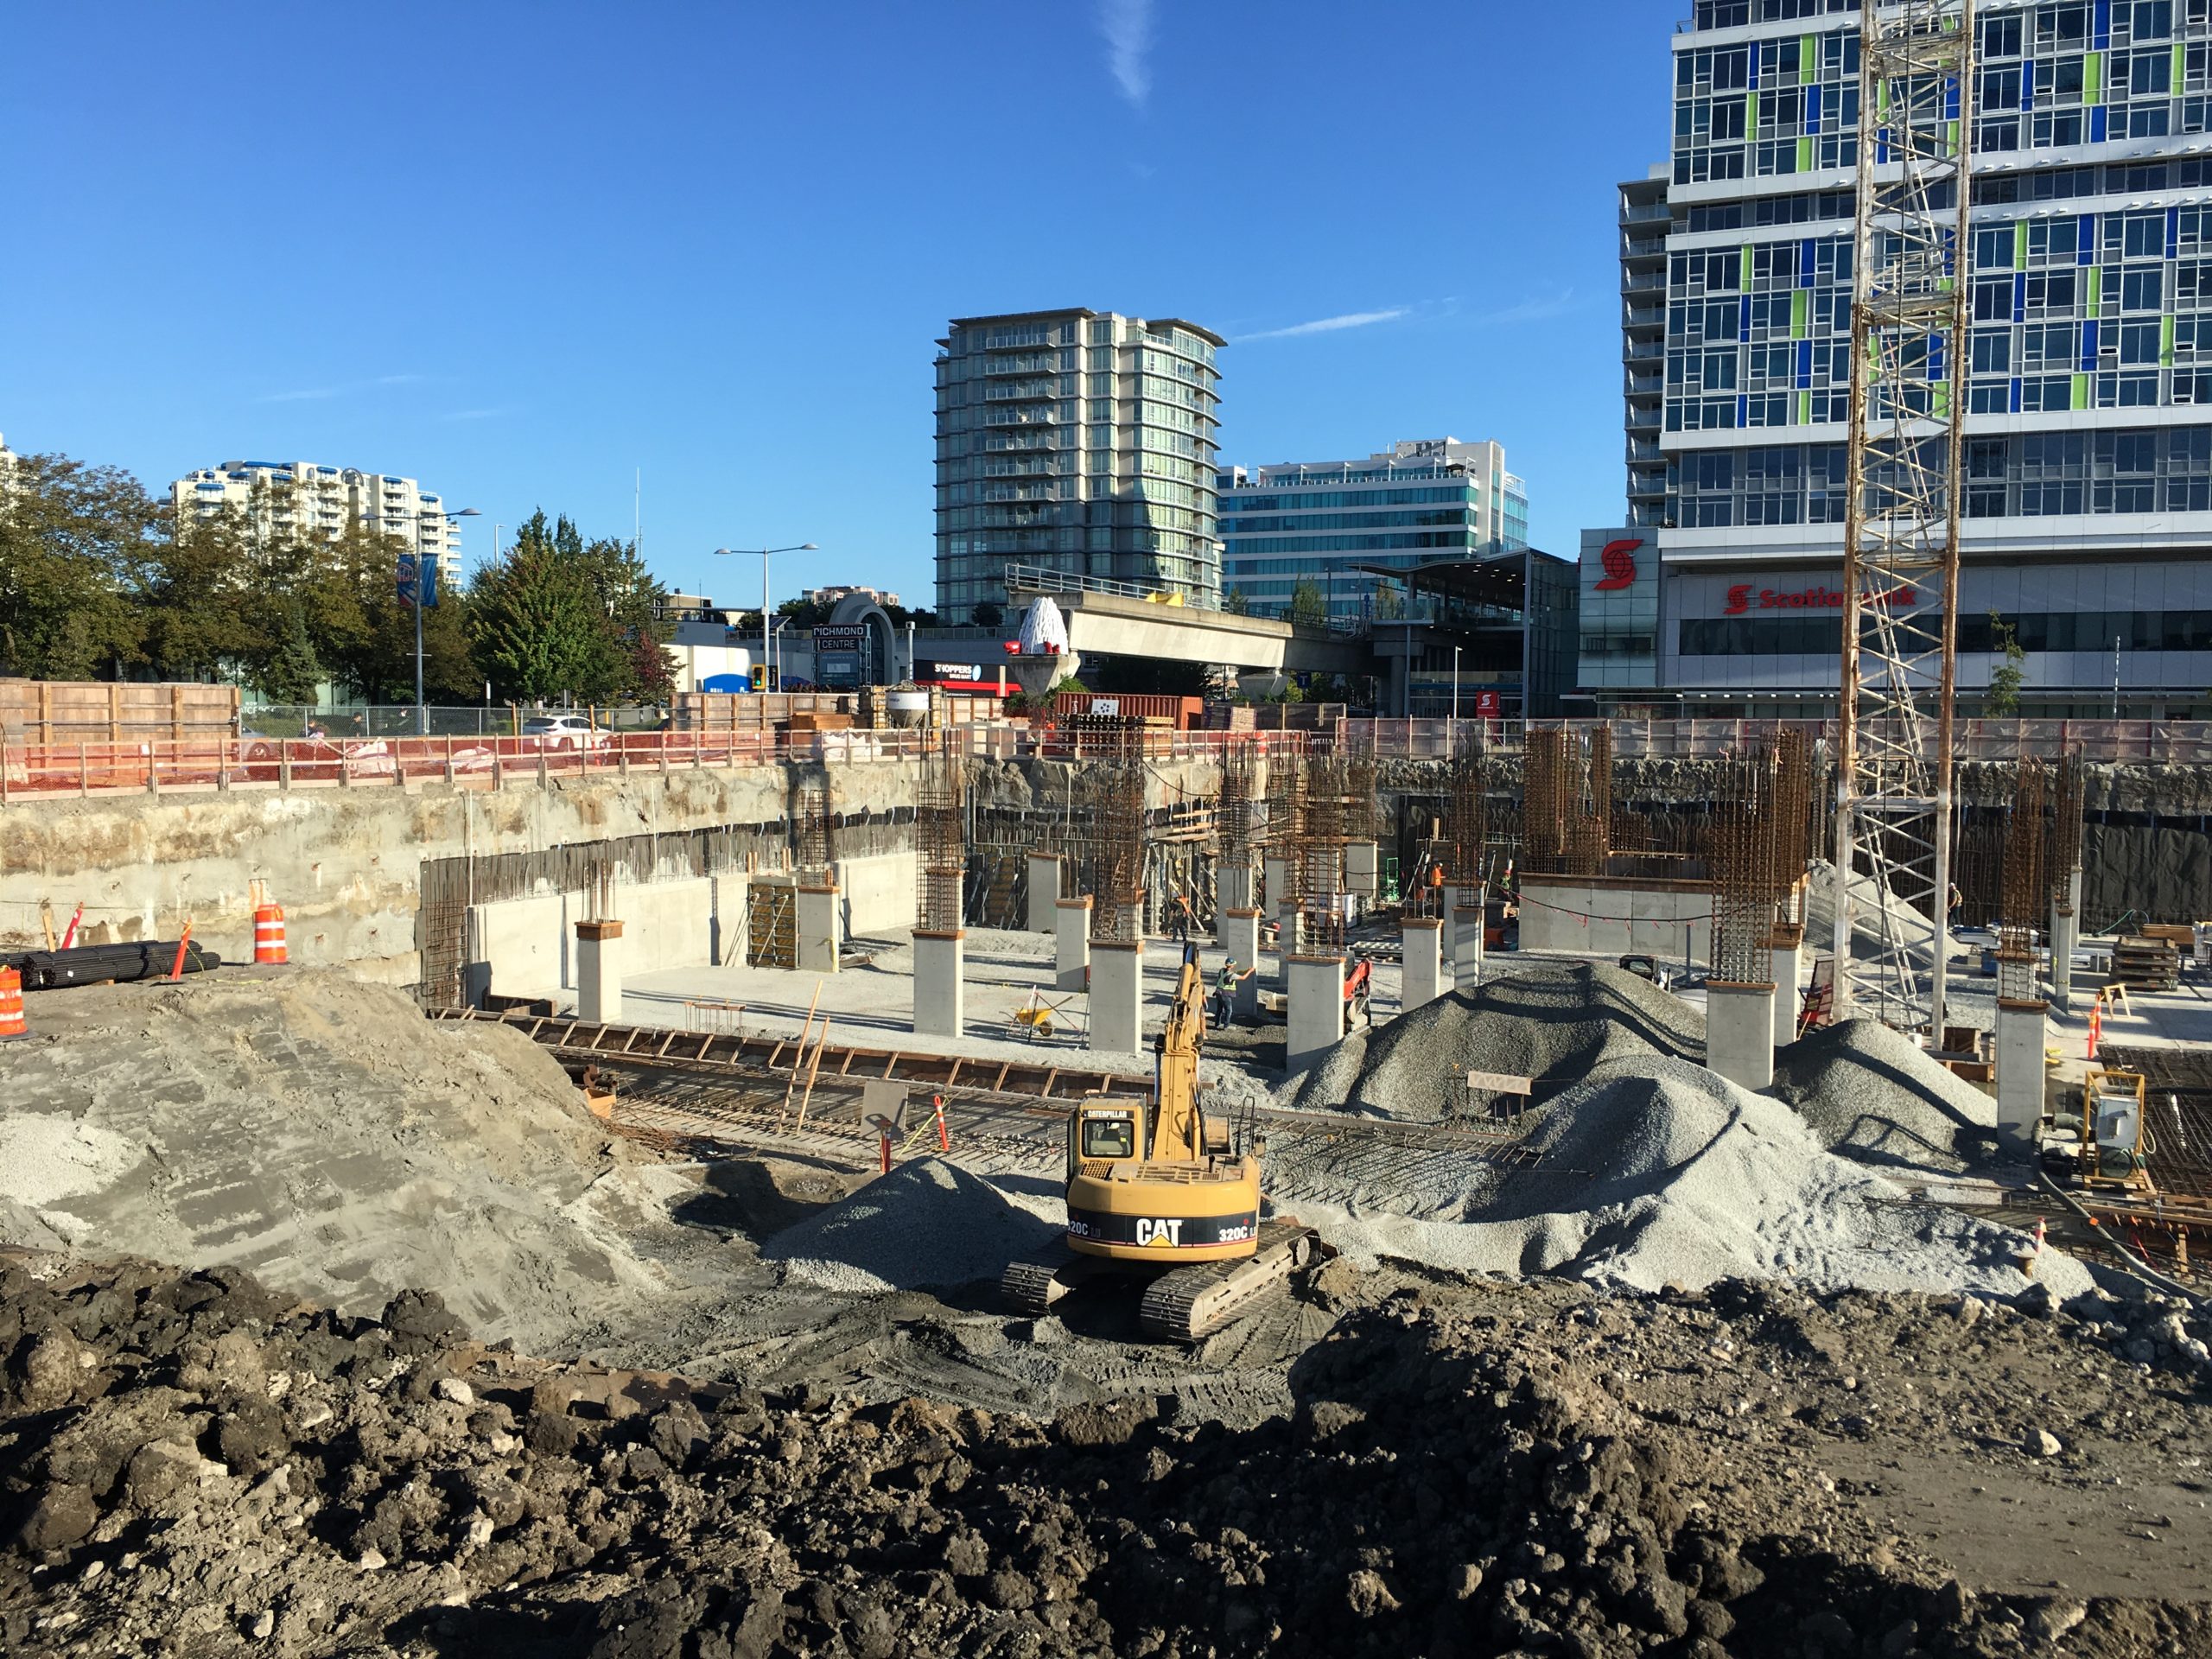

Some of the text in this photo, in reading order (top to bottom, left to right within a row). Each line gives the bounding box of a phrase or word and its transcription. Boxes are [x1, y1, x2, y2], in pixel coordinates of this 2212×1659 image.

[813, 626, 864, 636] RICHMOND
[822, 639, 855, 649] CENTRE
[1087, 1109, 1128, 1119] CATERPILLAR
[1136, 1218, 1183, 1248] CAT
[1218, 1225, 1248, 1243] 320C
